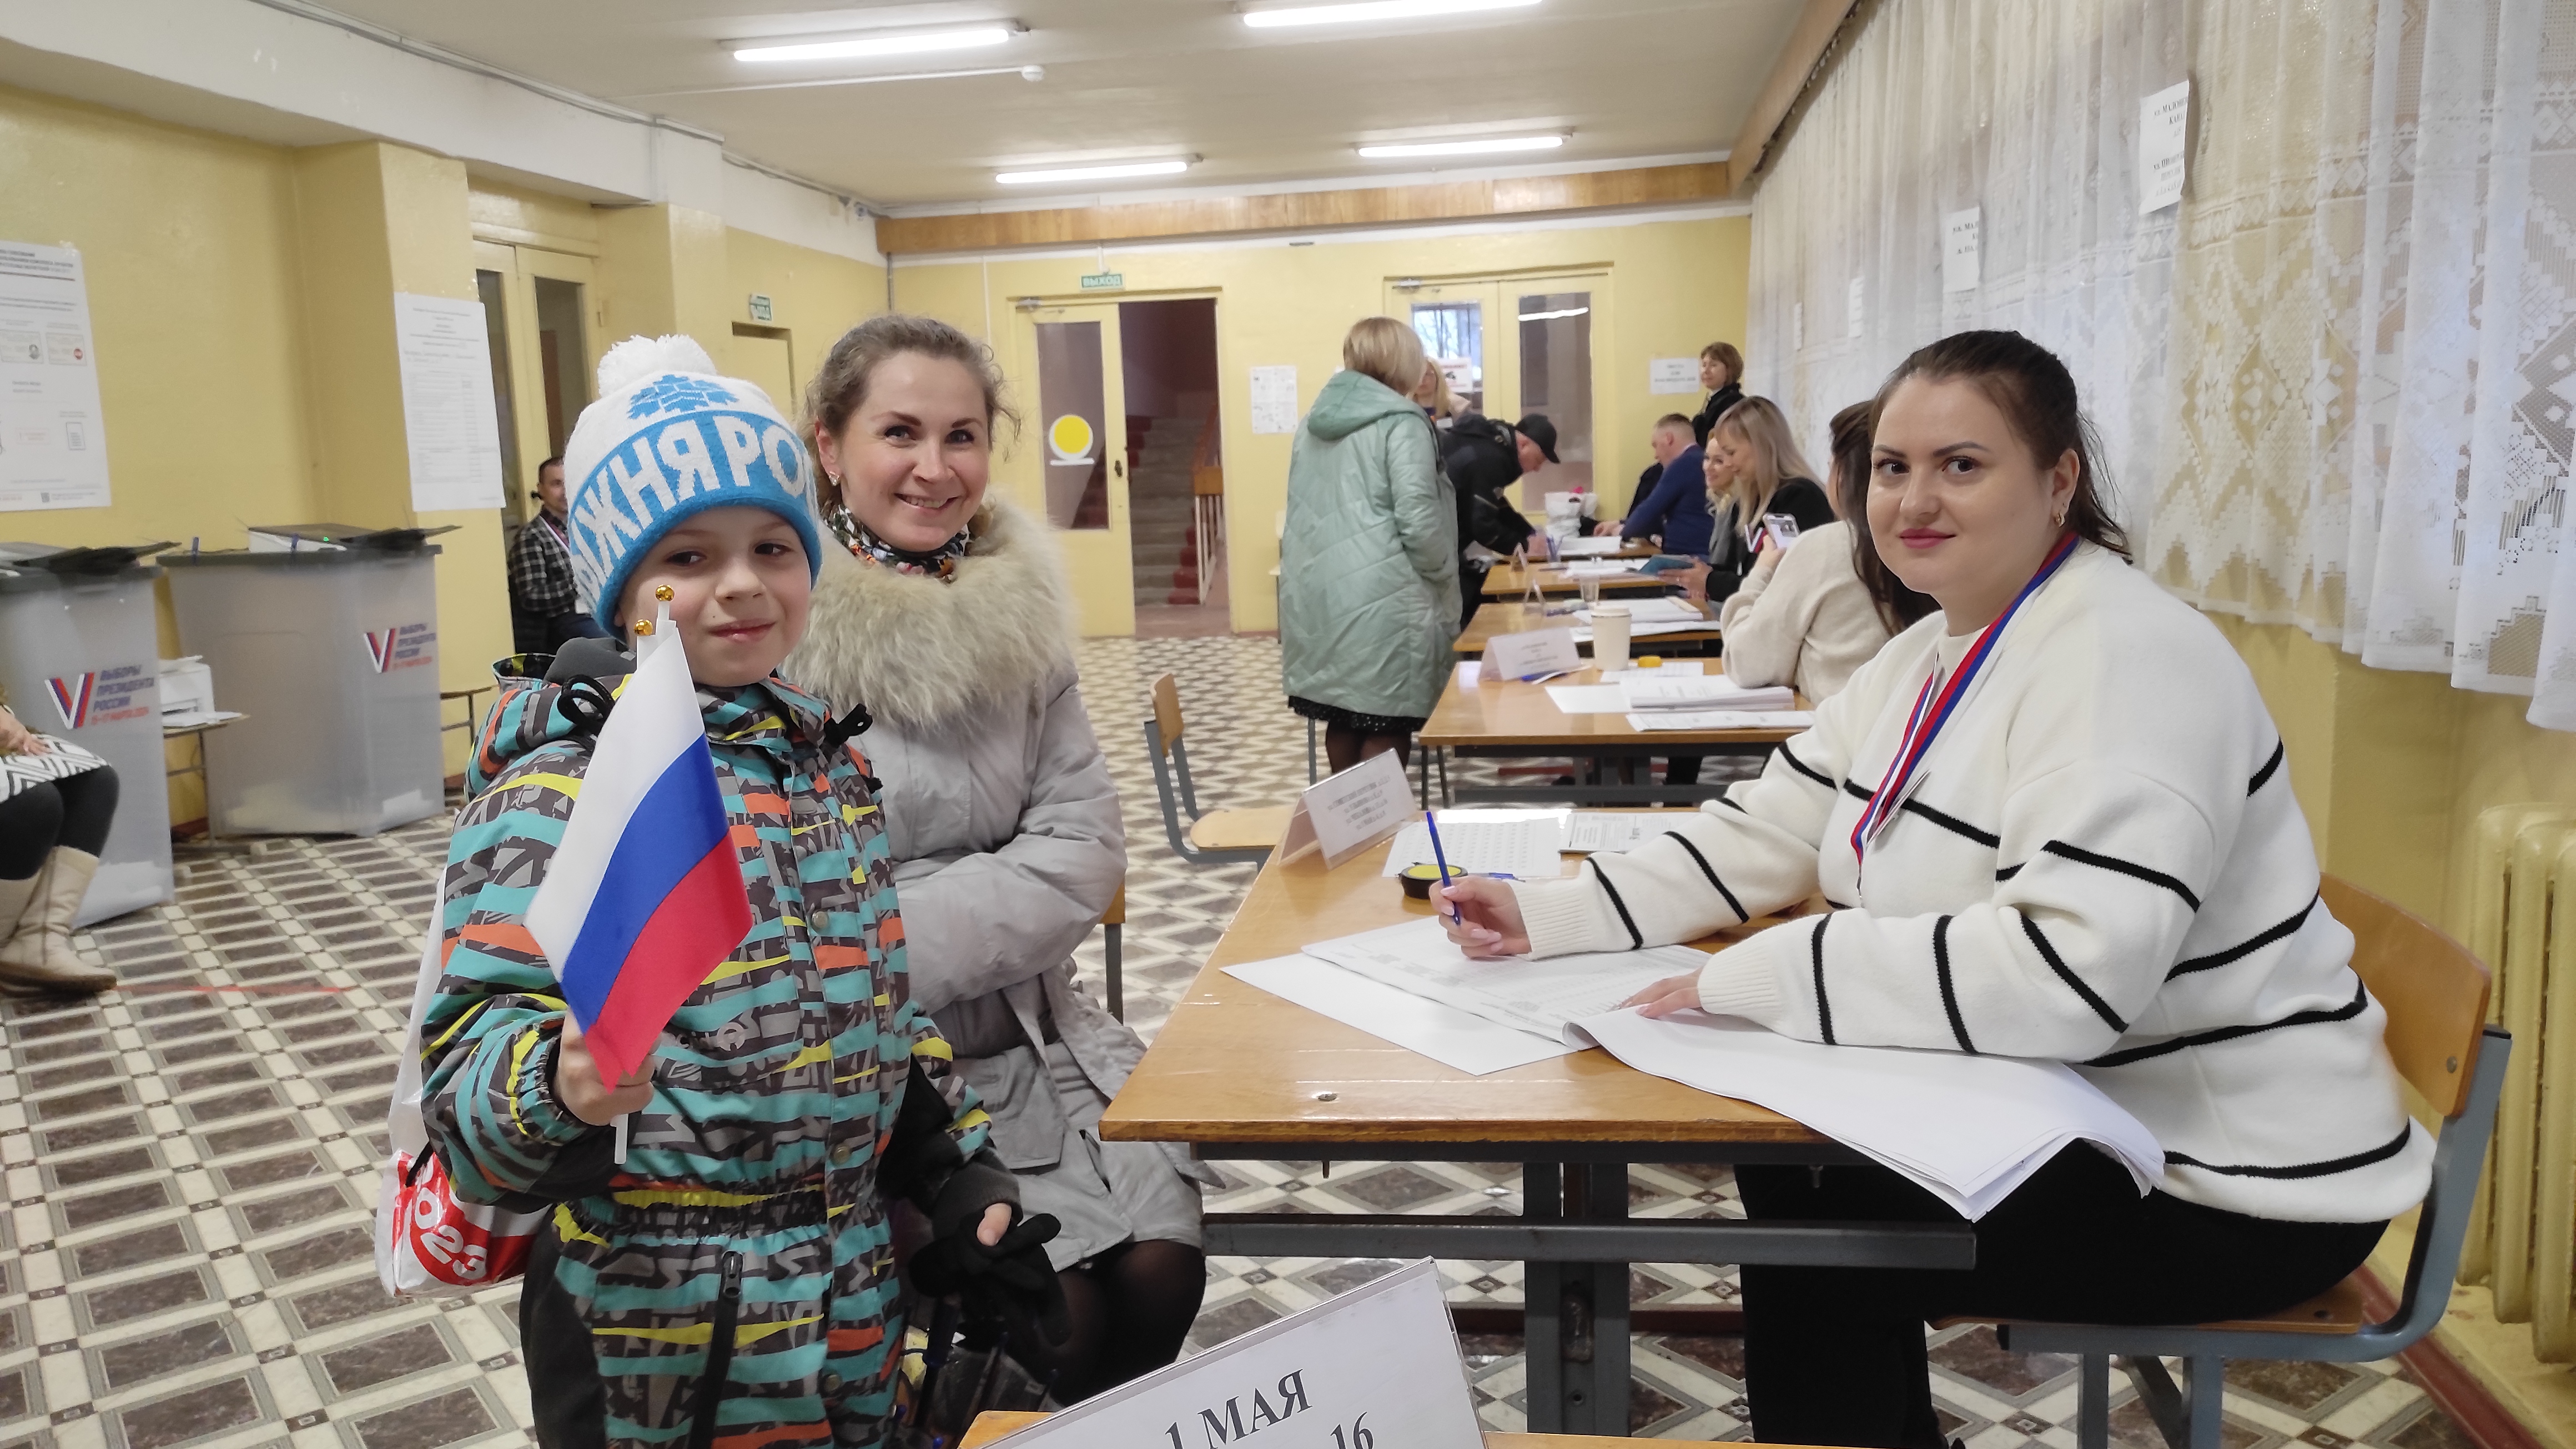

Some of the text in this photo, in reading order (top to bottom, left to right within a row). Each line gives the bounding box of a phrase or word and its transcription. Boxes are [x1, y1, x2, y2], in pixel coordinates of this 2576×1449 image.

[571, 419, 720, 608] ЫЖНЯ
[713, 416, 818, 523] РО
[1198, 1368, 1313, 1449] МАЯ
[1330, 1411, 1375, 1449] 16
